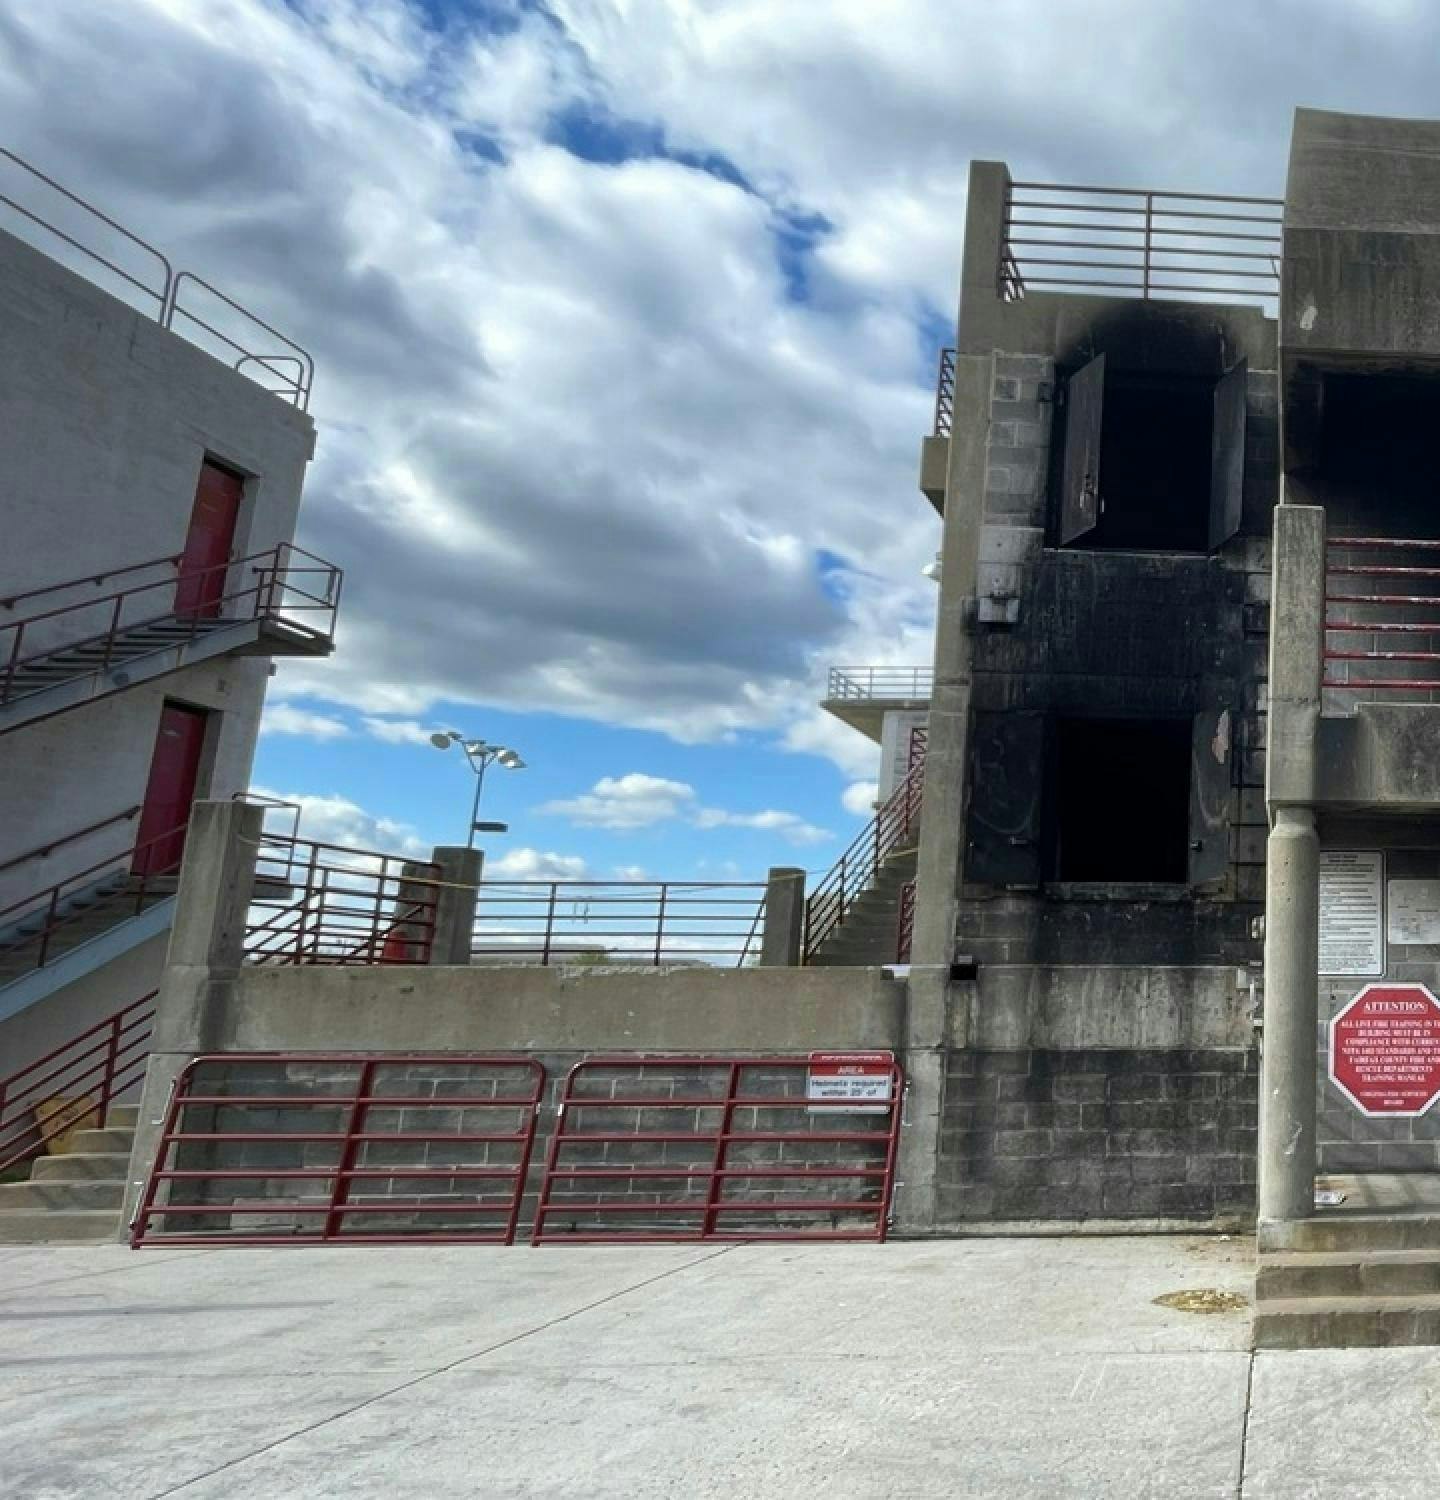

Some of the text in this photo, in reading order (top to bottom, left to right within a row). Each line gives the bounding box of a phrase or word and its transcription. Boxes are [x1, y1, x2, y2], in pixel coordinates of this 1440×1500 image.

[1342, 1020, 1354, 1028] ALL
[1356, 1020, 1371, 1028] LIVE
[1373, 1020, 1388, 1028] FIRE
[1390, 1020, 1423, 1028] TRAINING
[838, 1066, 864, 1074] AREA
